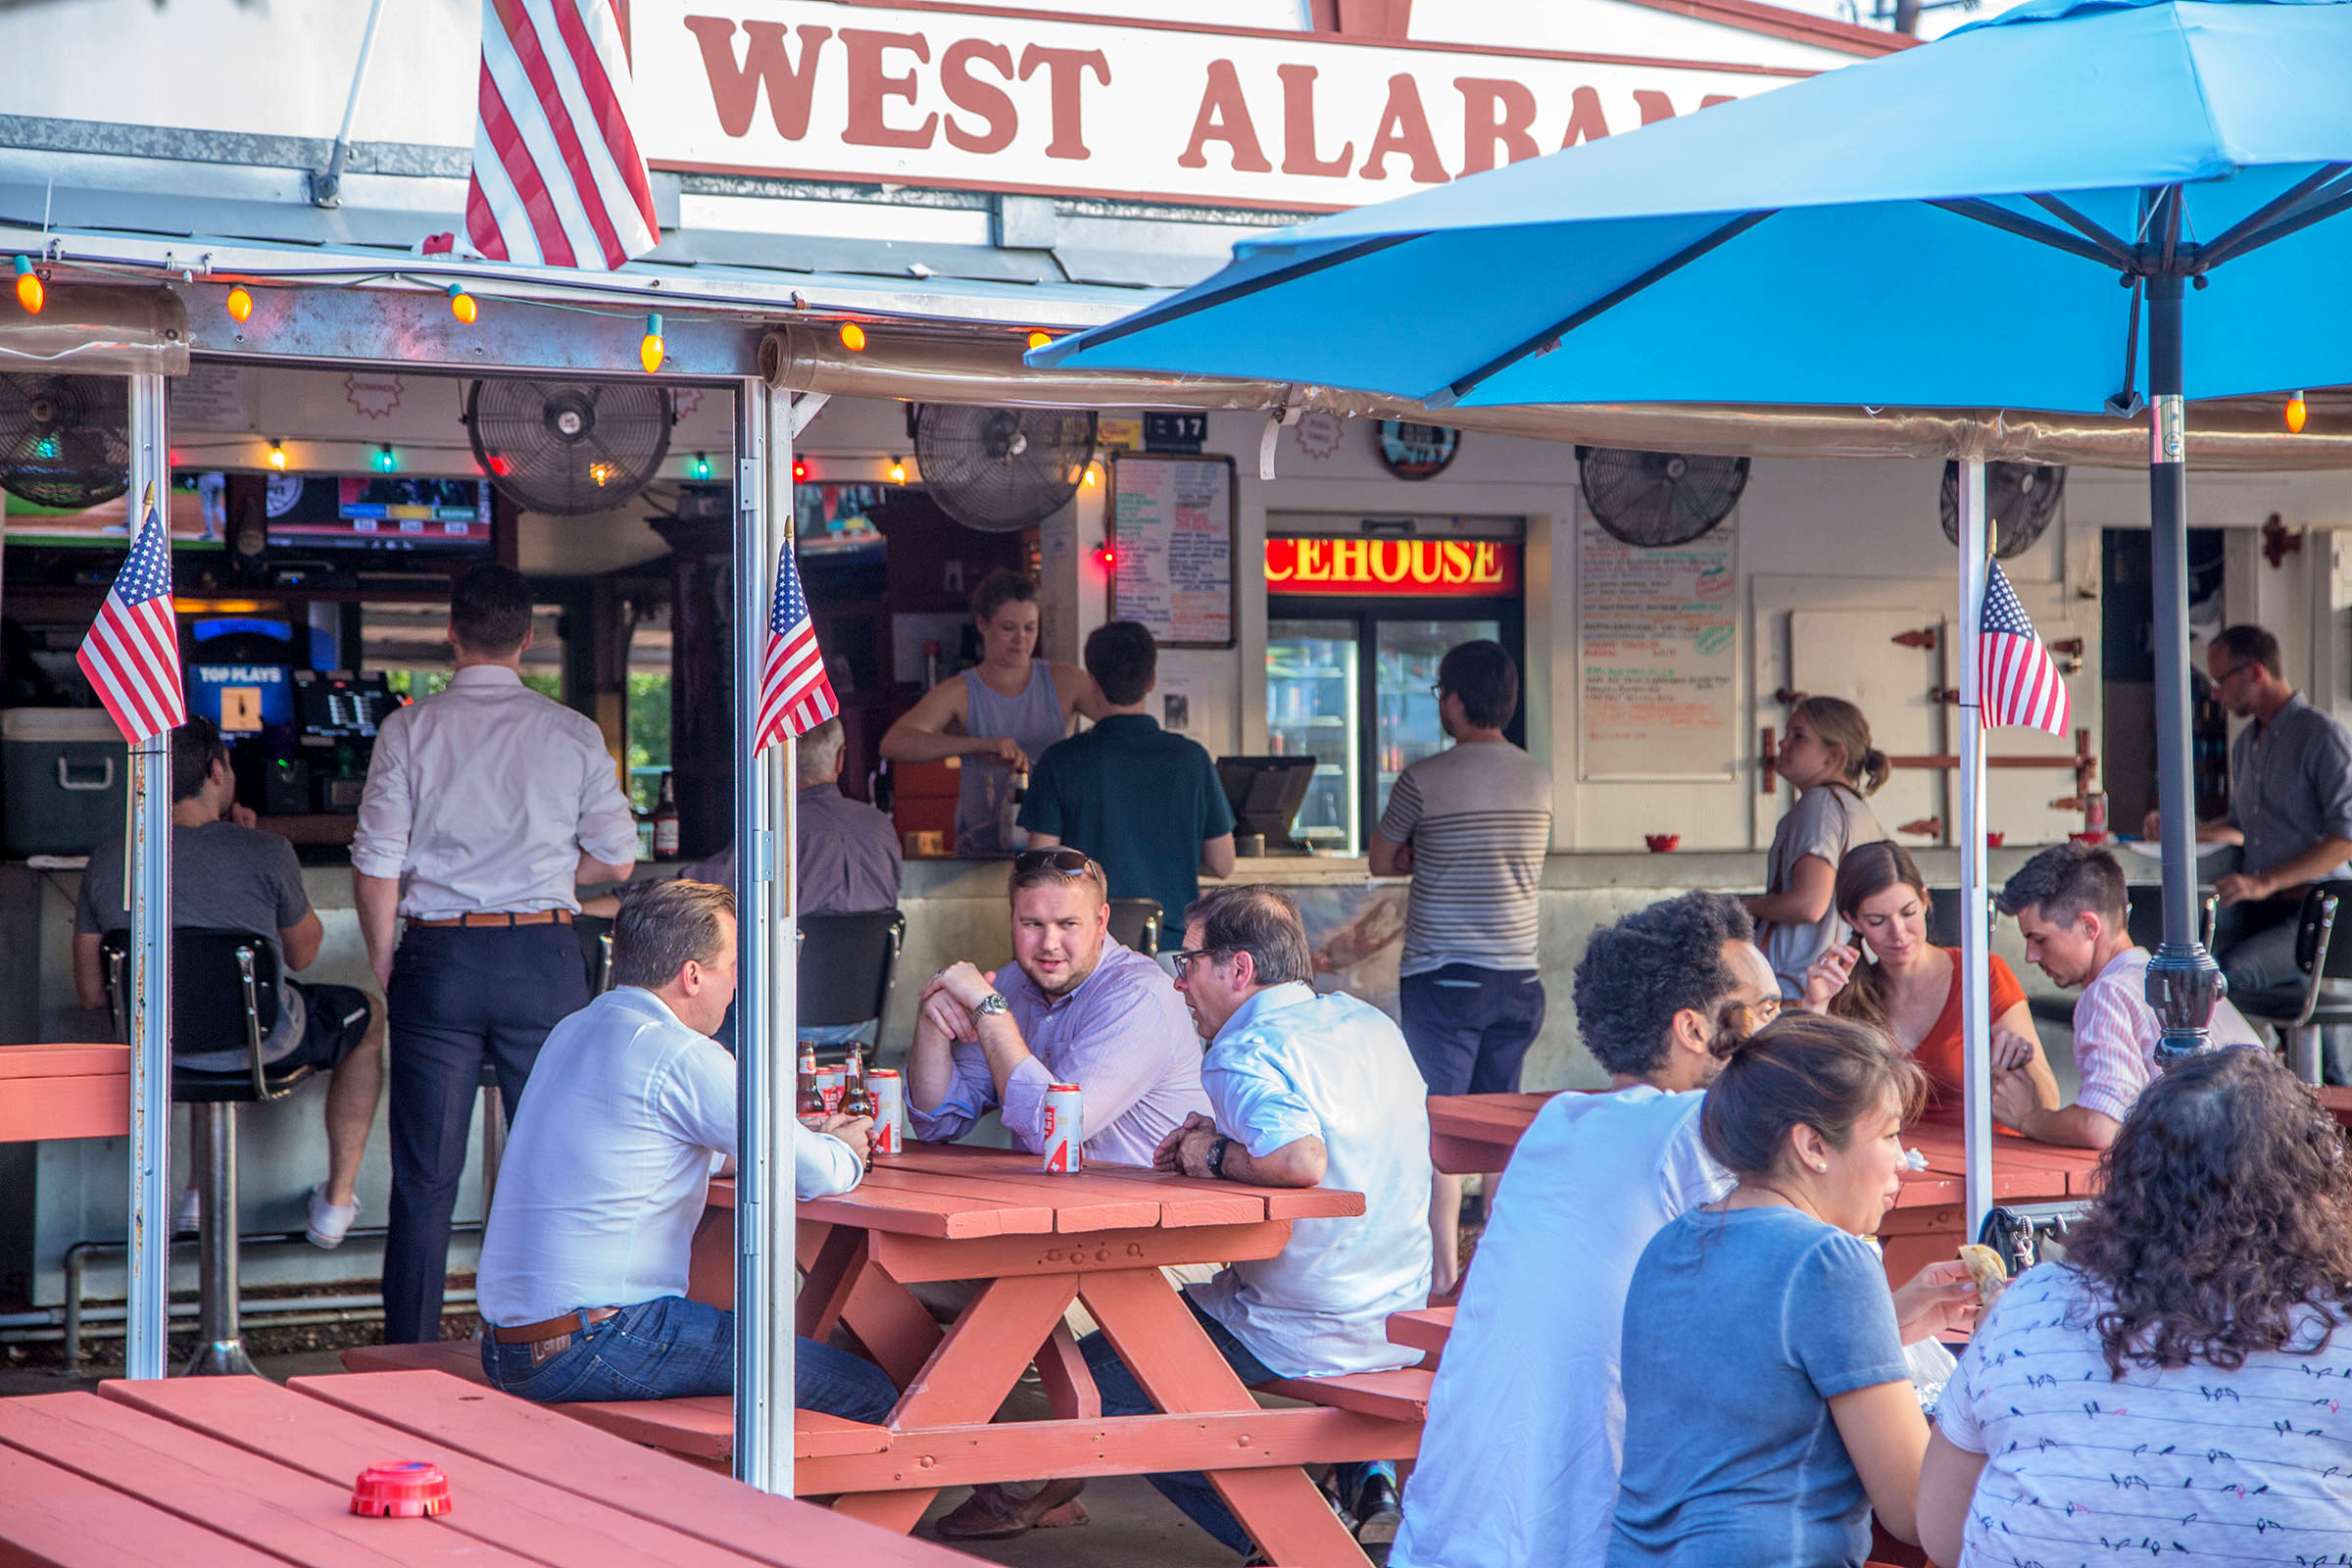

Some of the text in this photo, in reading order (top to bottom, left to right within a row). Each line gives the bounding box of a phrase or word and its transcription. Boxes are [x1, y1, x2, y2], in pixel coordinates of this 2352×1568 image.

[684, 15, 1740, 183] WEST ALABA
[199, 667, 282, 683] TOP PLAYS
